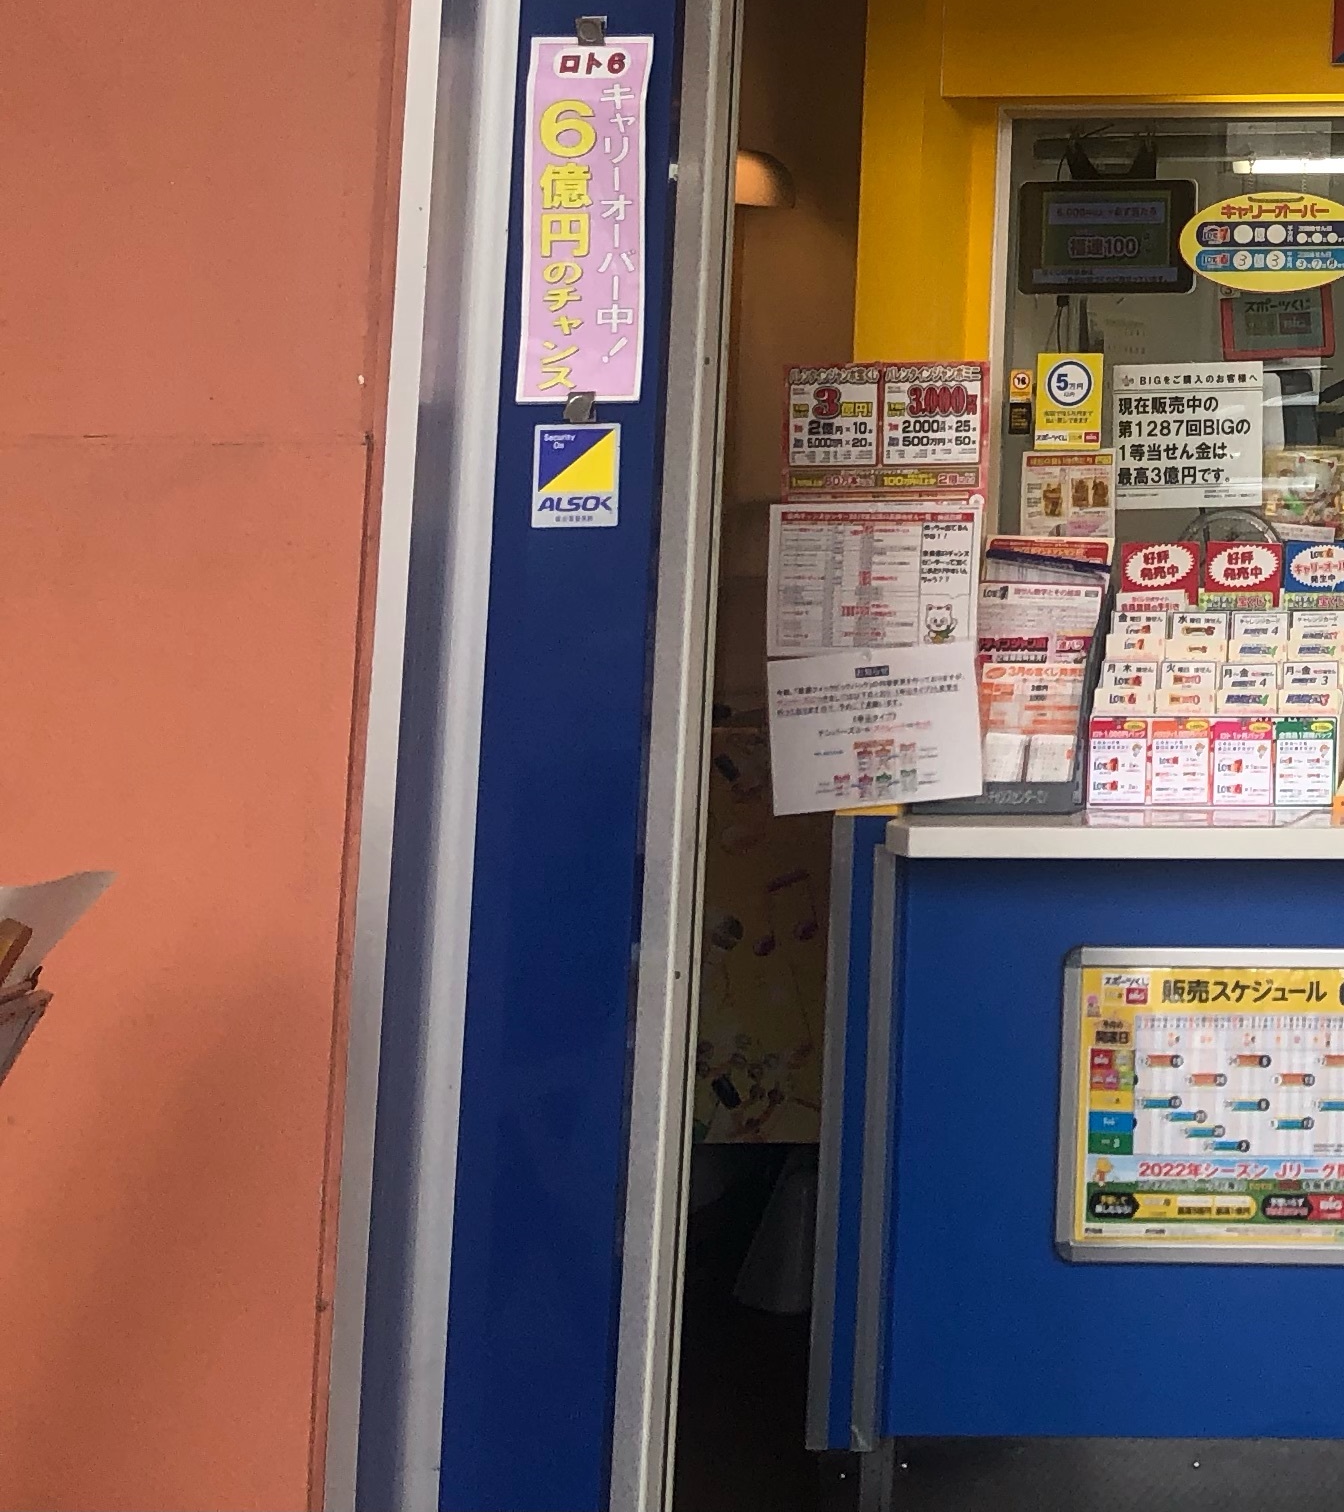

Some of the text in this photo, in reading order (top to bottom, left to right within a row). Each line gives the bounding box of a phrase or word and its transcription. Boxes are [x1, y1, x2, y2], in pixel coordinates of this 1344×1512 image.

[558, 53, 627, 75] ロト6
[1220, 203, 1330, 219] キャリーオーバー
[538, 100, 597, 390] 6億円のチャンス
[1245, 299, 1311, 312] スポーツくじ
[1139, 373, 1258, 386] BIGをご購入のお客様へ
[1118, 396, 1219, 415] 現在販売中の
[1118, 418, 1251, 438] 第1287回BIGの
[1117, 466, 1231, 486] 最高3億円です。
[538, 496, 612, 512] ALSOK
[1161, 979, 1328, 1005] 販売スケジュール
[1138, 1161, 1268, 1179] 2022年シーズン
